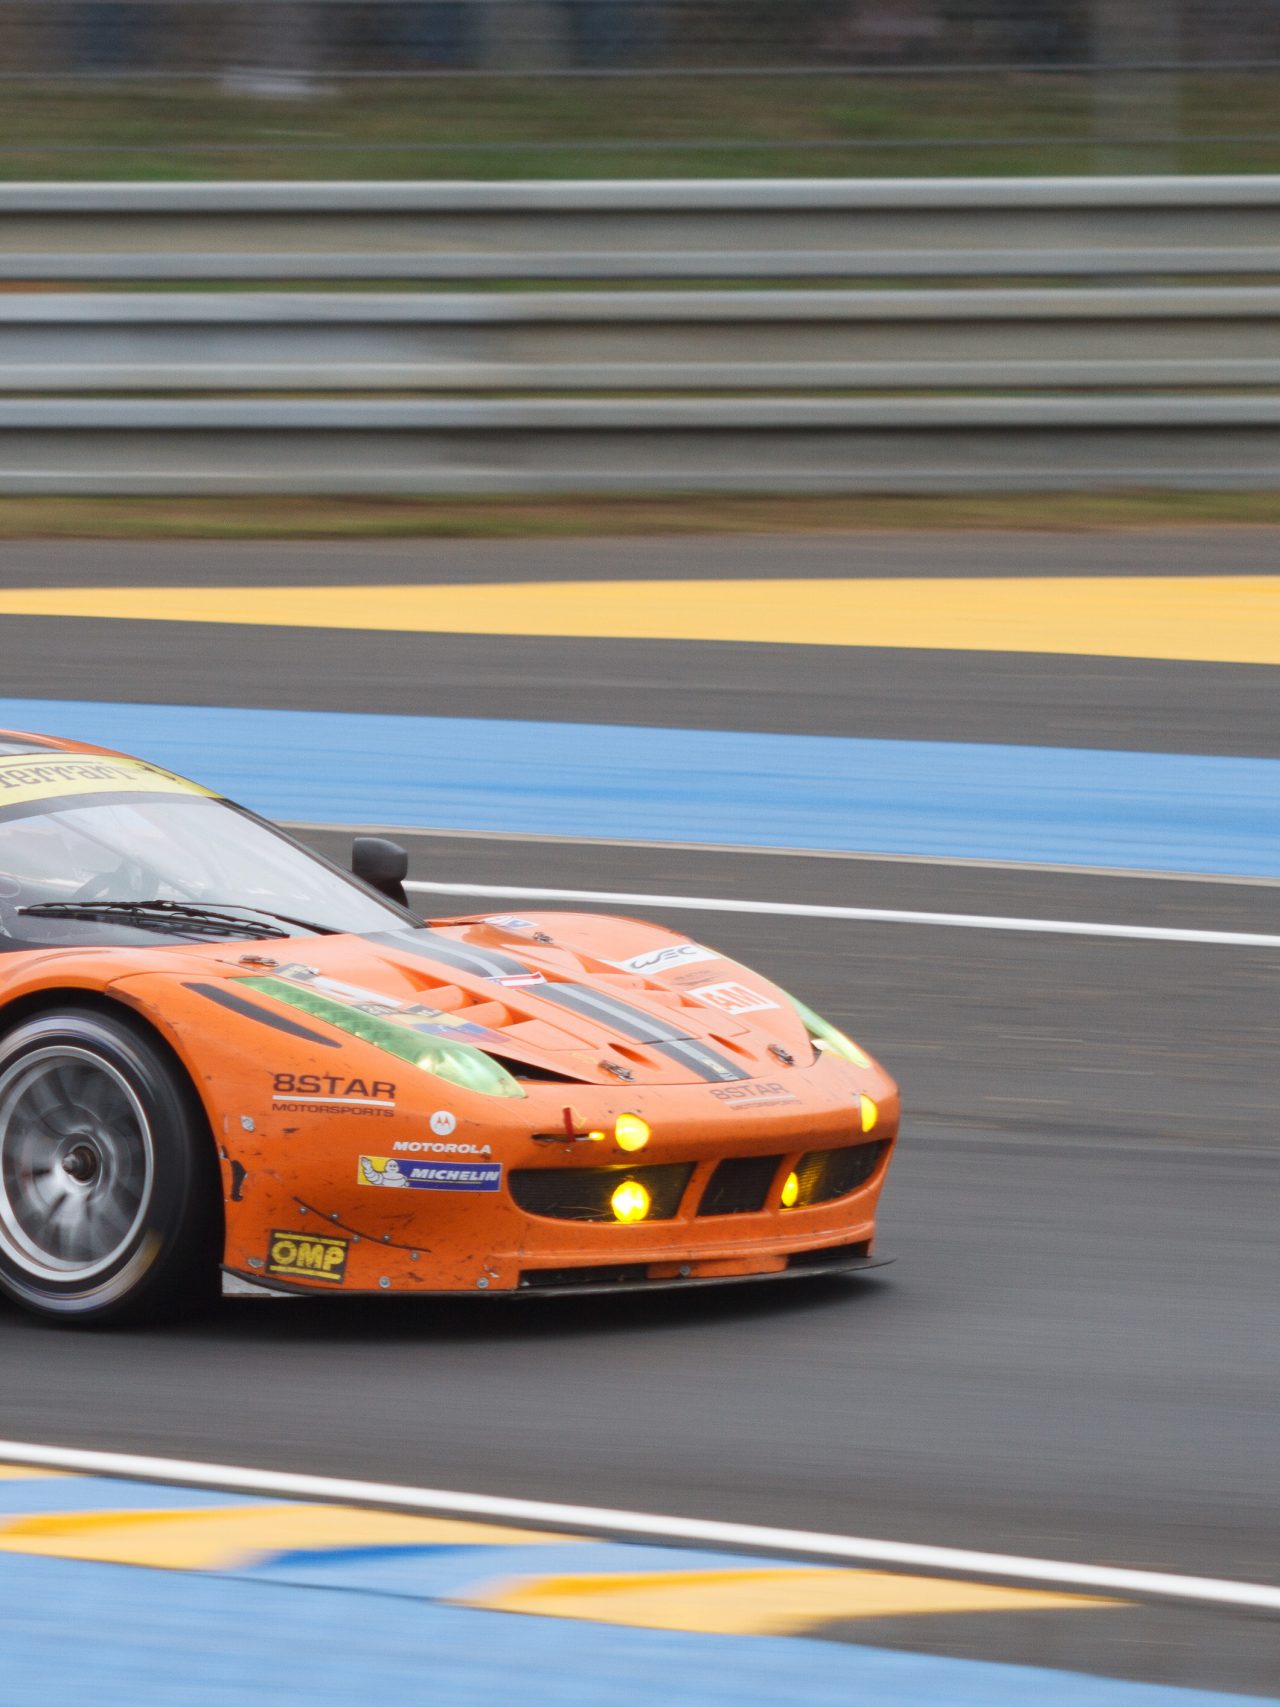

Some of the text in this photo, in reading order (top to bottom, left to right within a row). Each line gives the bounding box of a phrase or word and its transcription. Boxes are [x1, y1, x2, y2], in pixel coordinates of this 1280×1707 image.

[631, 944, 697, 969] WEC
[700, 986, 770, 1011] AM
[272, 1073, 396, 1099] 8STAR
[710, 1083, 790, 1100] 8STAR
[272, 1103, 395, 1118] MOTORSPORTS
[392, 1141, 492, 1154] MOTOROLA
[410, 1167, 500, 1182] MICHELIN
[271, 1241, 345, 1271] OMP
